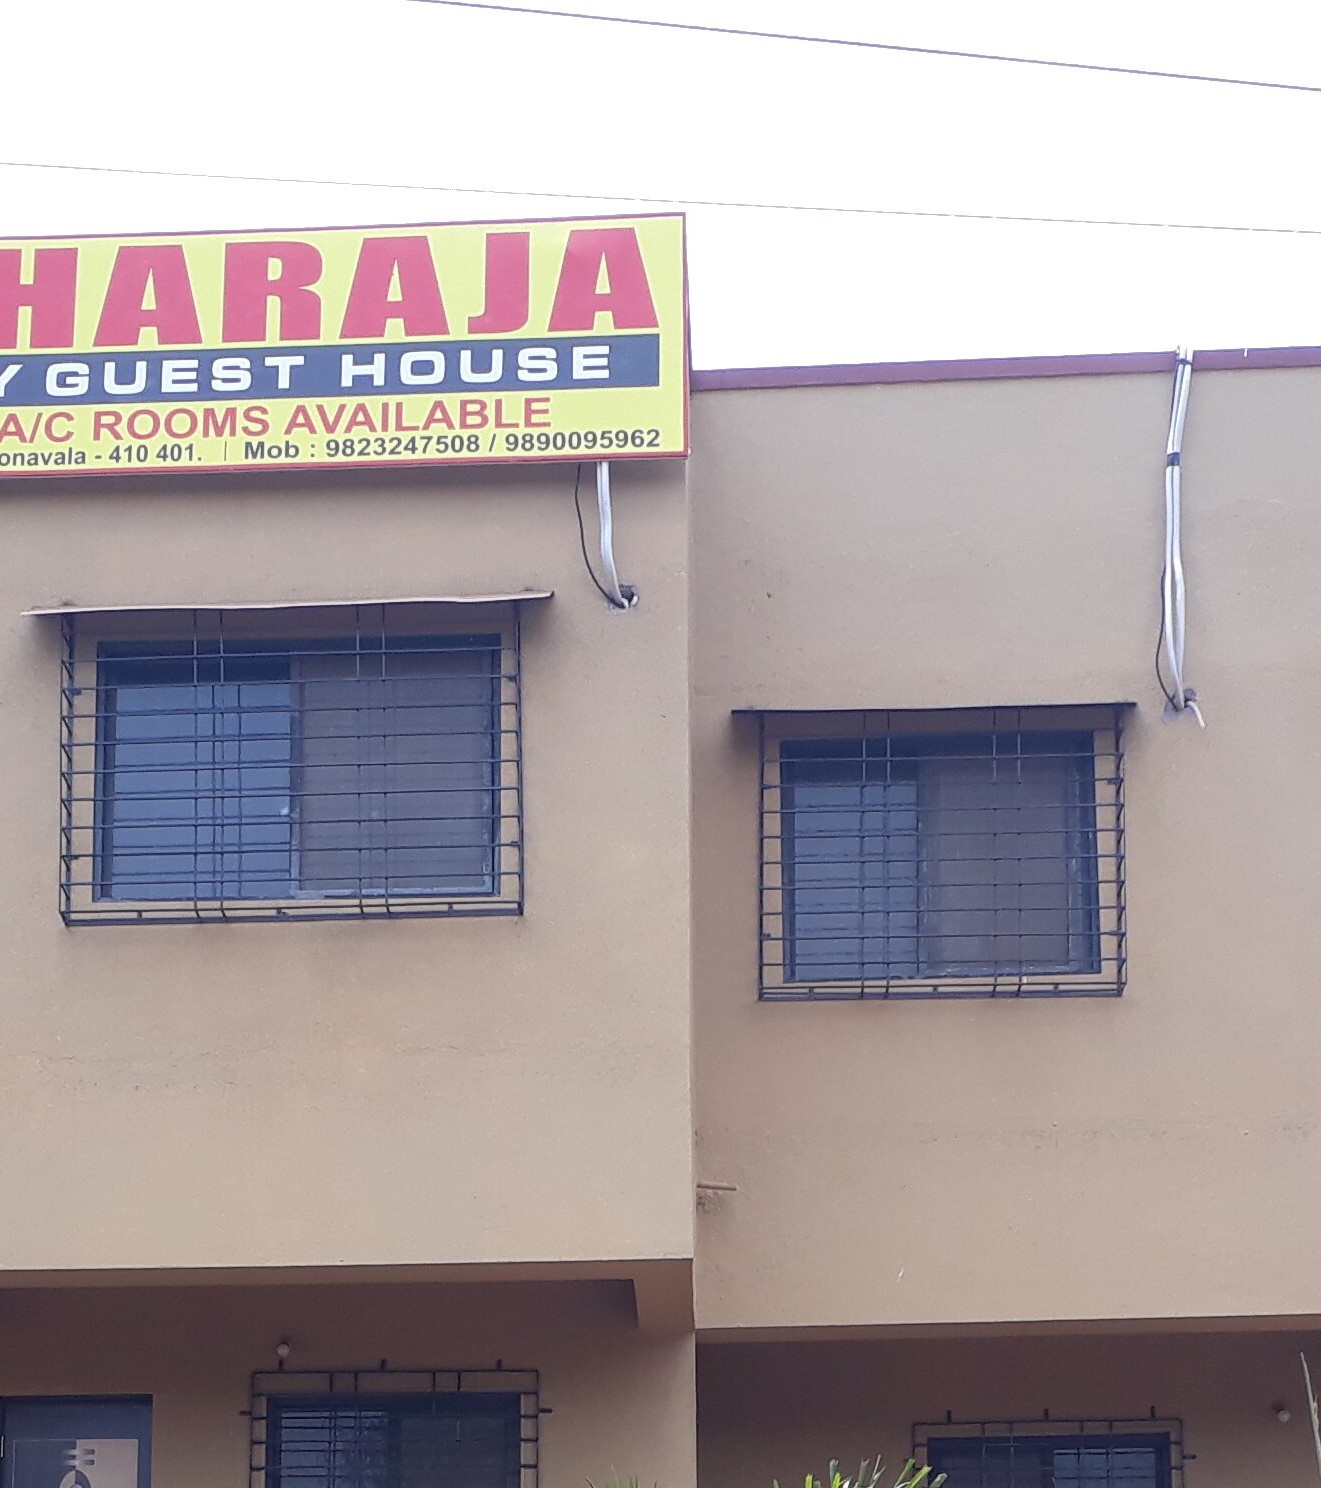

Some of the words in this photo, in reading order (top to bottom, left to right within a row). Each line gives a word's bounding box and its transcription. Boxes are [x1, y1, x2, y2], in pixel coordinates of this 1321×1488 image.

[44, 354, 306, 398] GUEST
[340, 345, 612, 388] HOUSE
[92, 405, 270, 442] ROOMS
[283, 397, 552, 436] AVAILABLE
[108, 444, 149, 464] 410
[155, 443, 202, 462] 401.
[244, 440, 300, 460] Mob
[325, 434, 480, 457] 9823247508
[488, 433, 497, 453] /
[505, 429, 661, 452] 9890095962
